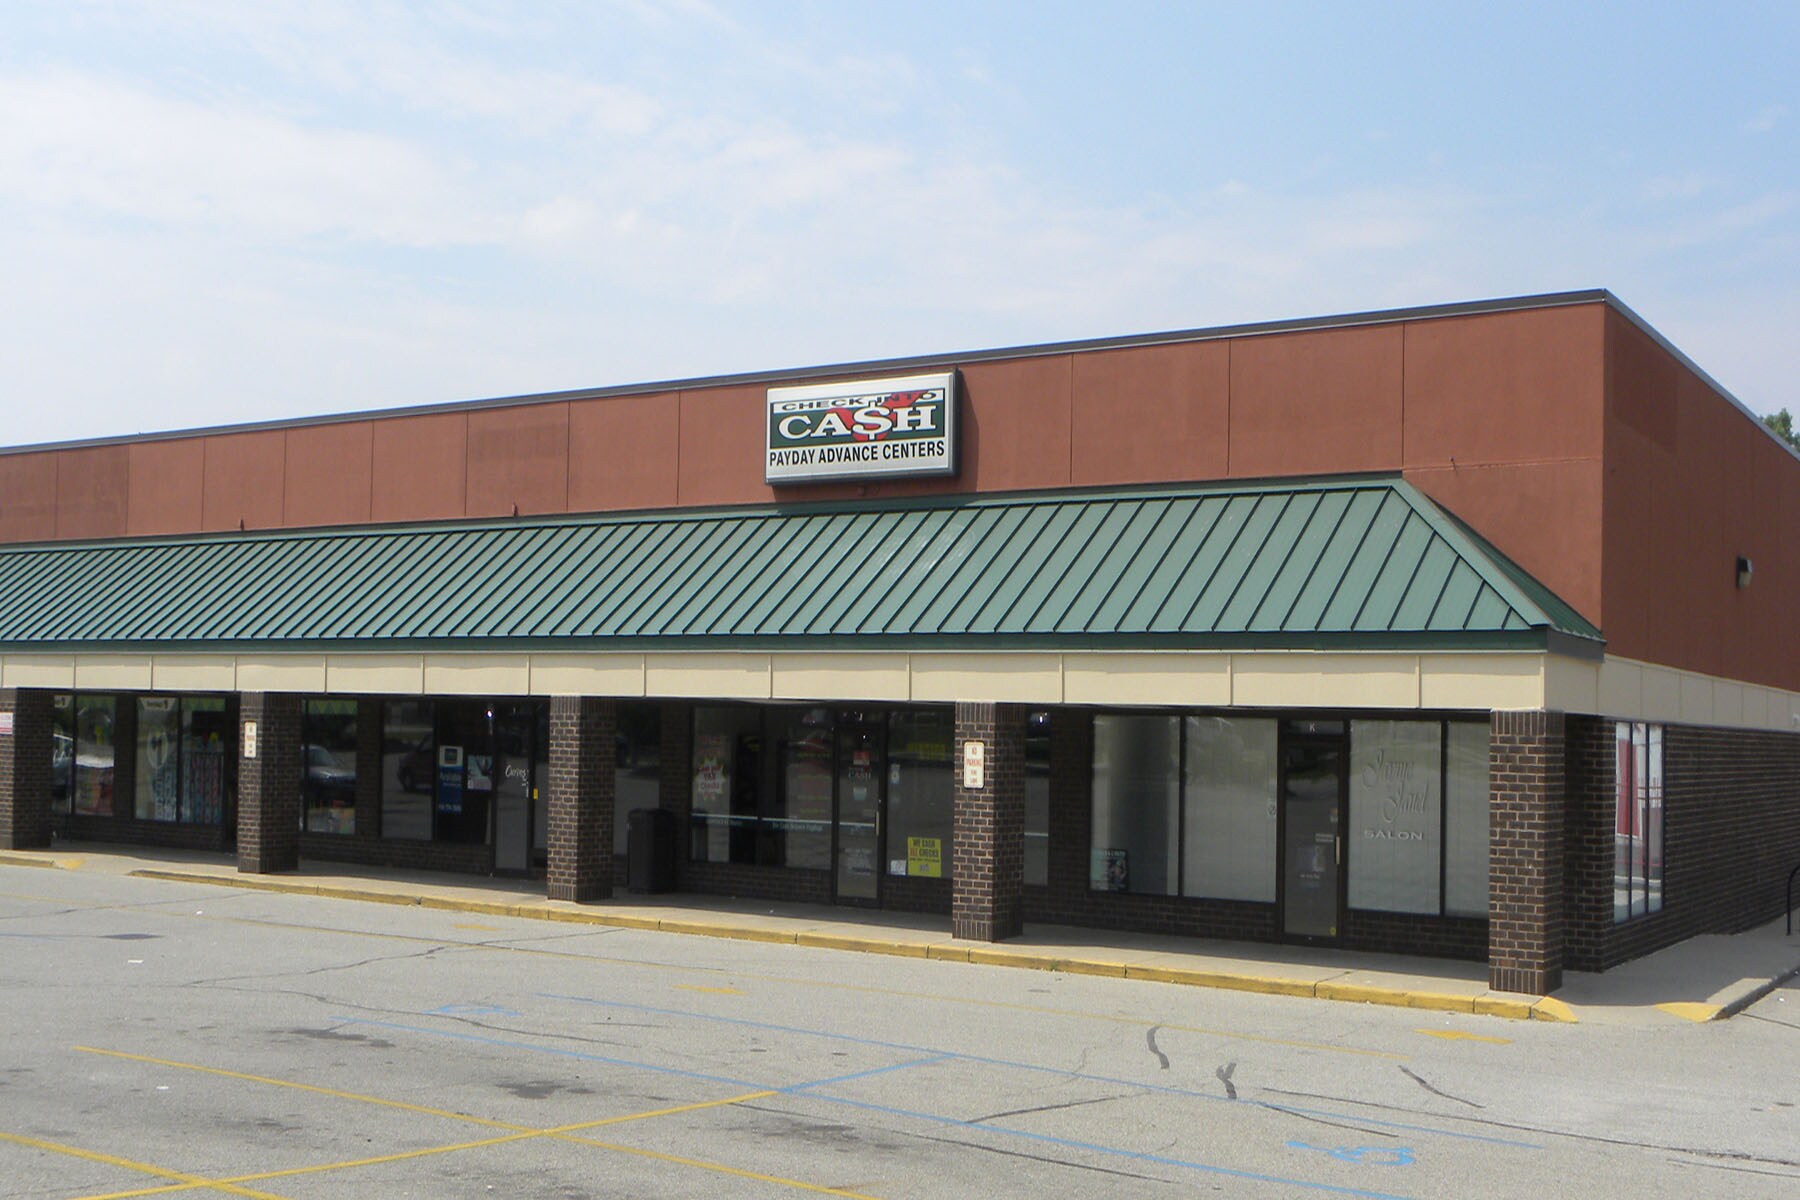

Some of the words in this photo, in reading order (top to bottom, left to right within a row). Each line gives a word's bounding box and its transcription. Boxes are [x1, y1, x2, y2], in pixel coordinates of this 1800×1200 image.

[782, 397, 862, 411] CHECK
[769, 448, 815, 467] PAYDAY
[818, 445, 878, 464] ADVANCE
[882, 440, 945, 460] CENTERS
[1364, 829, 1424, 841] SALON
